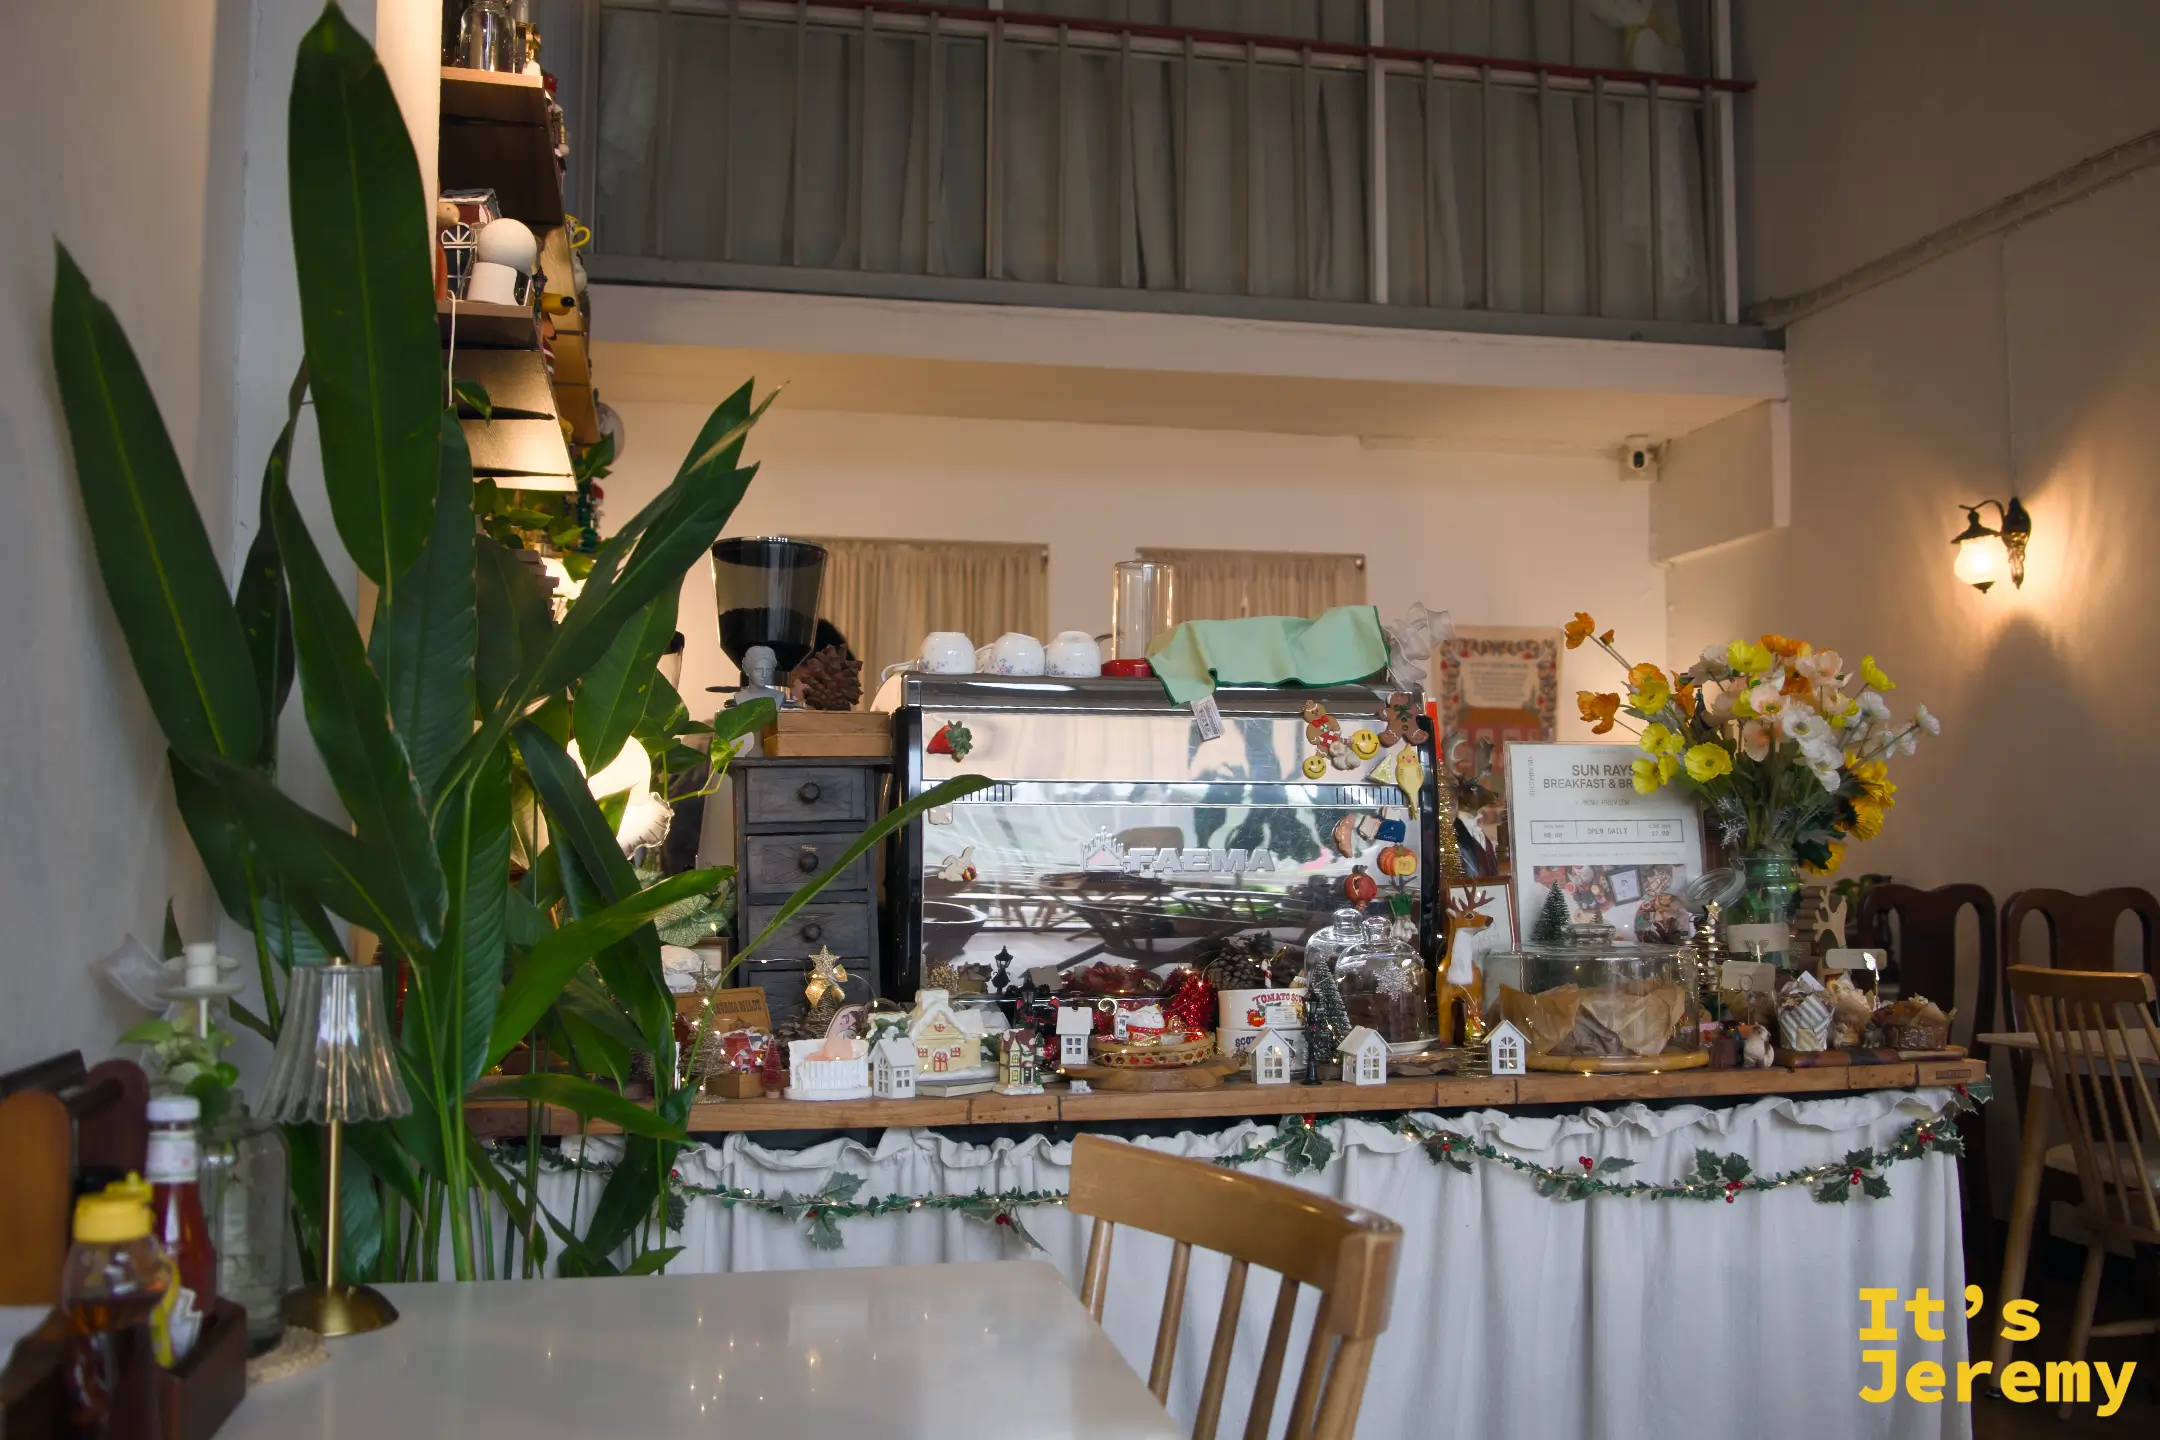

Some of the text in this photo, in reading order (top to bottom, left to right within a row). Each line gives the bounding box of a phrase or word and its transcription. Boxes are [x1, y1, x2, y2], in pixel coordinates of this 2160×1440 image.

[1572, 764, 1635, 776] SUN RAYS
[1543, 779, 1605, 789] BREAKFAST
[1608, 779, 1616, 789] &
[1127, 848, 1275, 872] FAEMA
[1252, 992, 1291, 1005] TOMATO
[1235, 1035, 1257, 1048] SCOT
